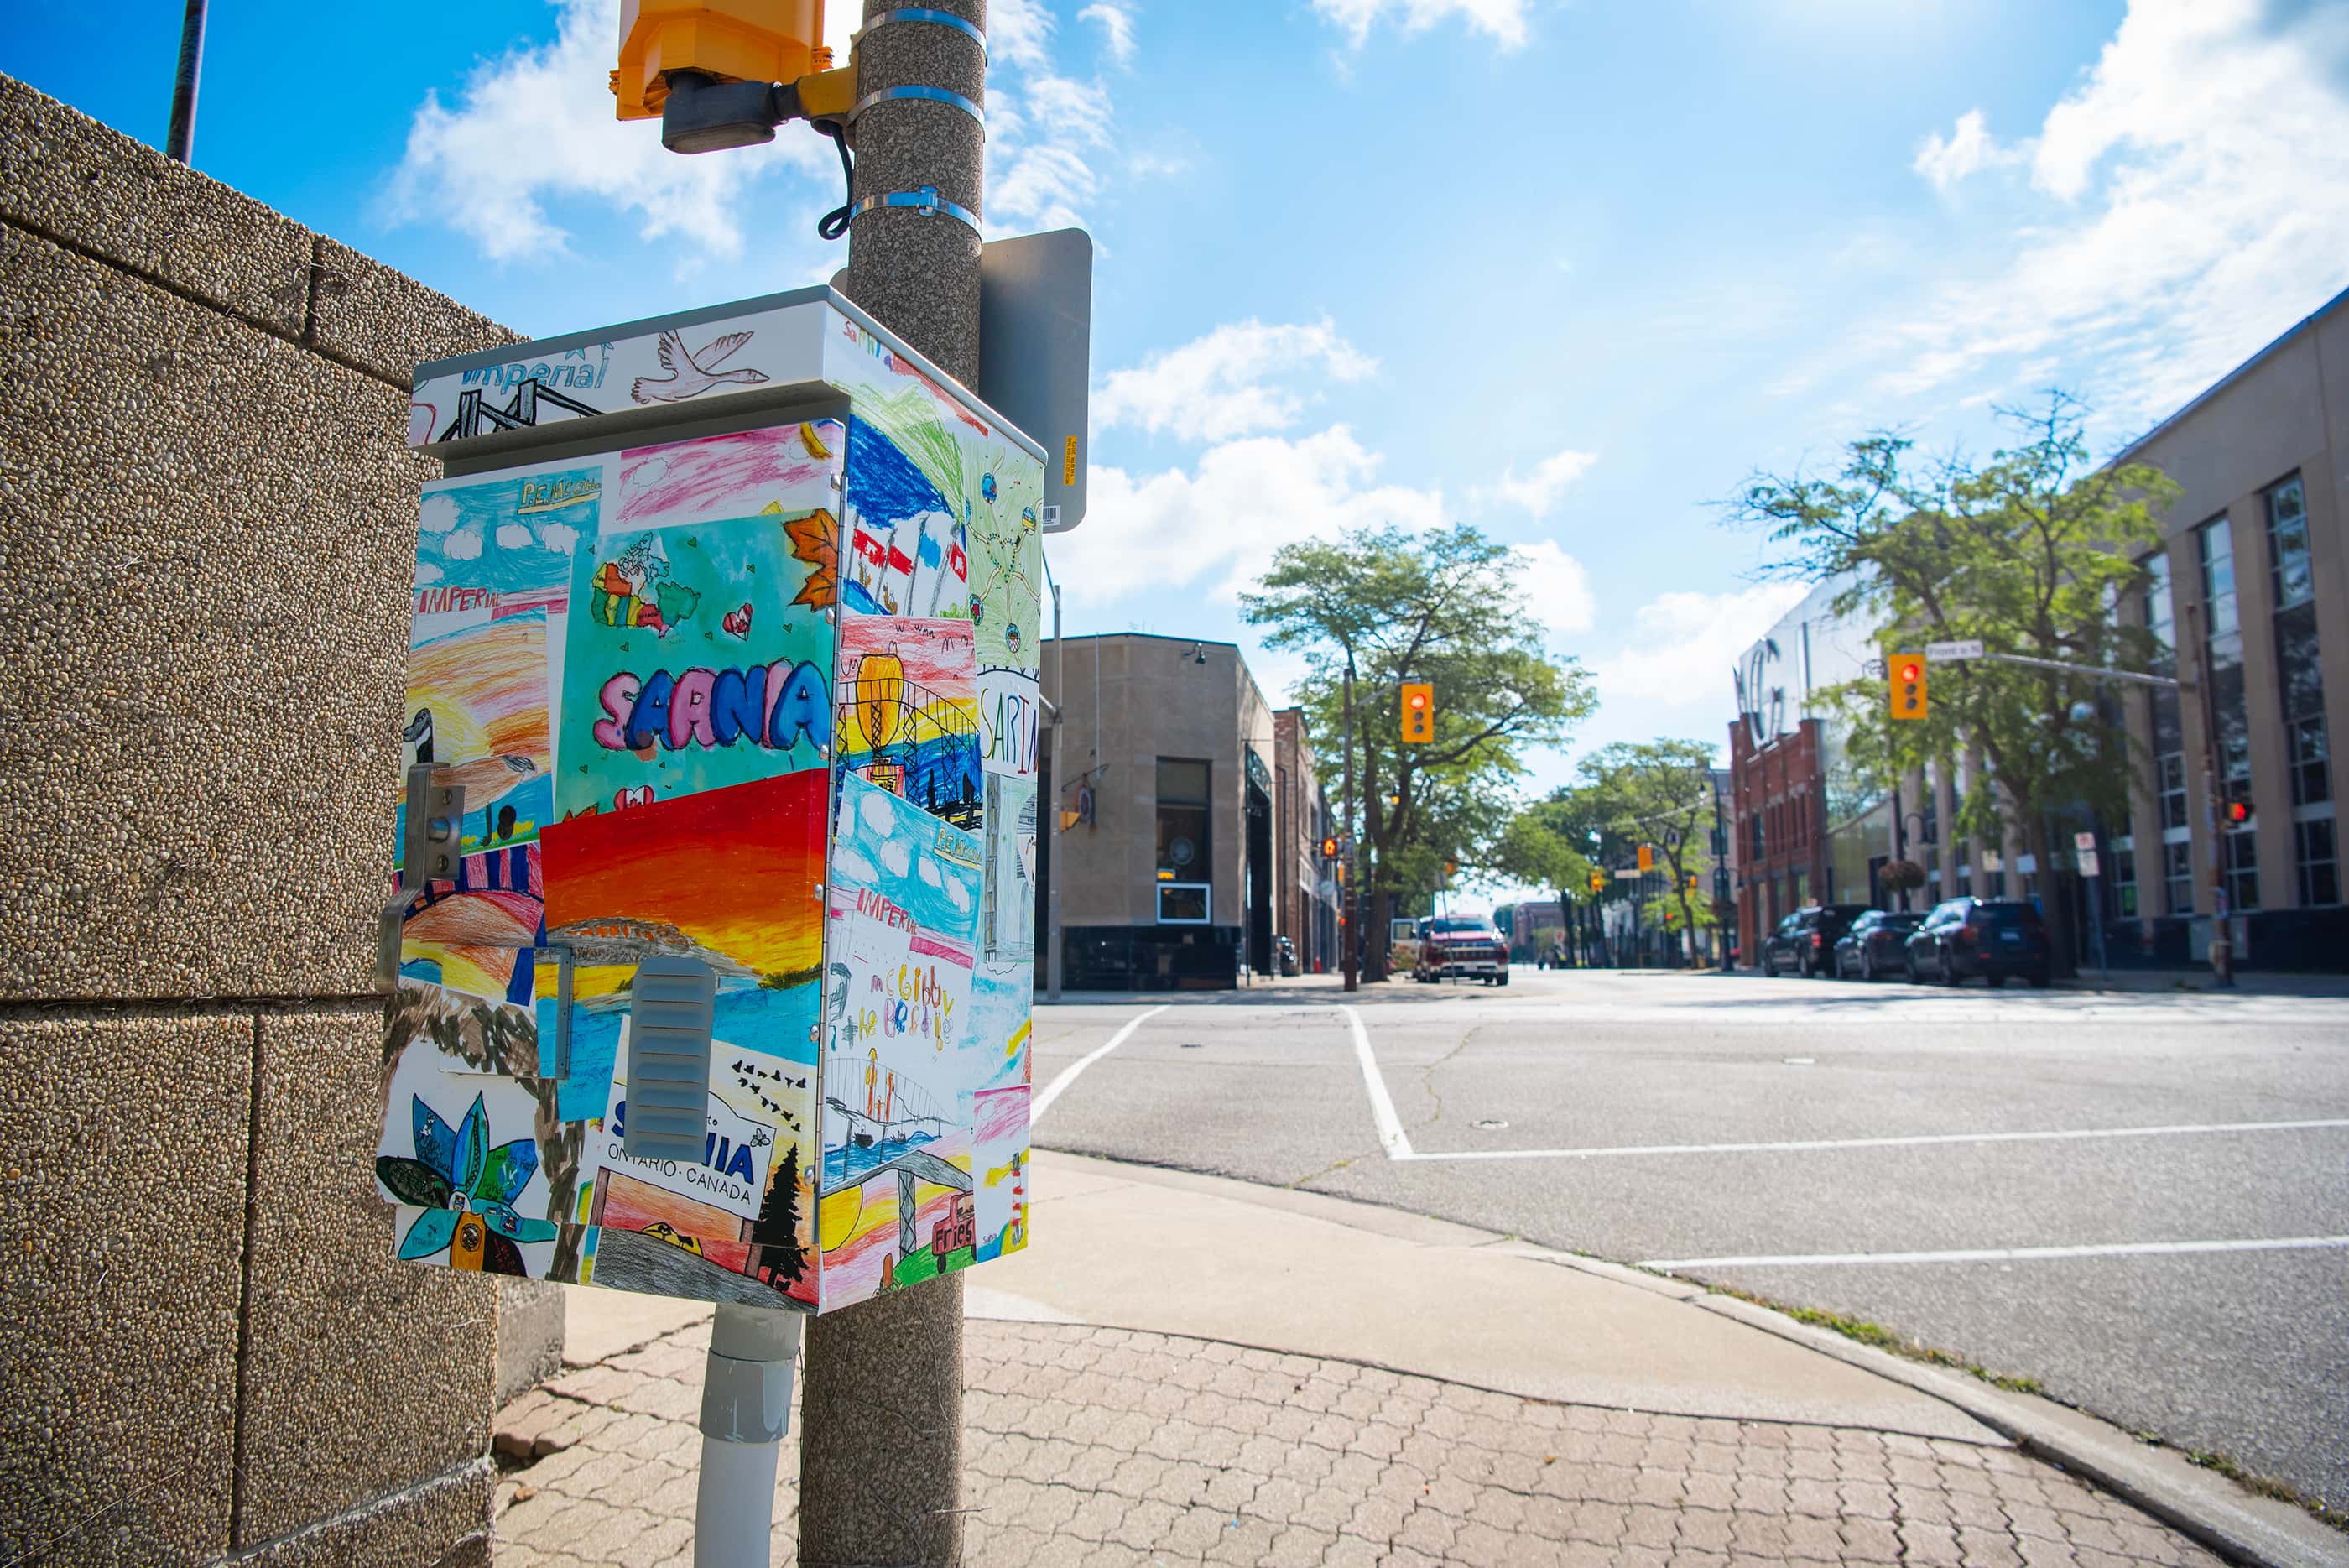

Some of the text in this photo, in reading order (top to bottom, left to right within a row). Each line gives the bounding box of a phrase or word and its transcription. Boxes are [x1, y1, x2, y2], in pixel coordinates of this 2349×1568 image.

[419, 586, 501, 614] IMPERIAL
[592, 657, 831, 751] SARNIA
[857, 888, 917, 935] IMPERIAL
[707, 1115, 718, 1127] to
[686, 1167, 751, 1205] CANADA
[935, 1218, 972, 1252] Fries
